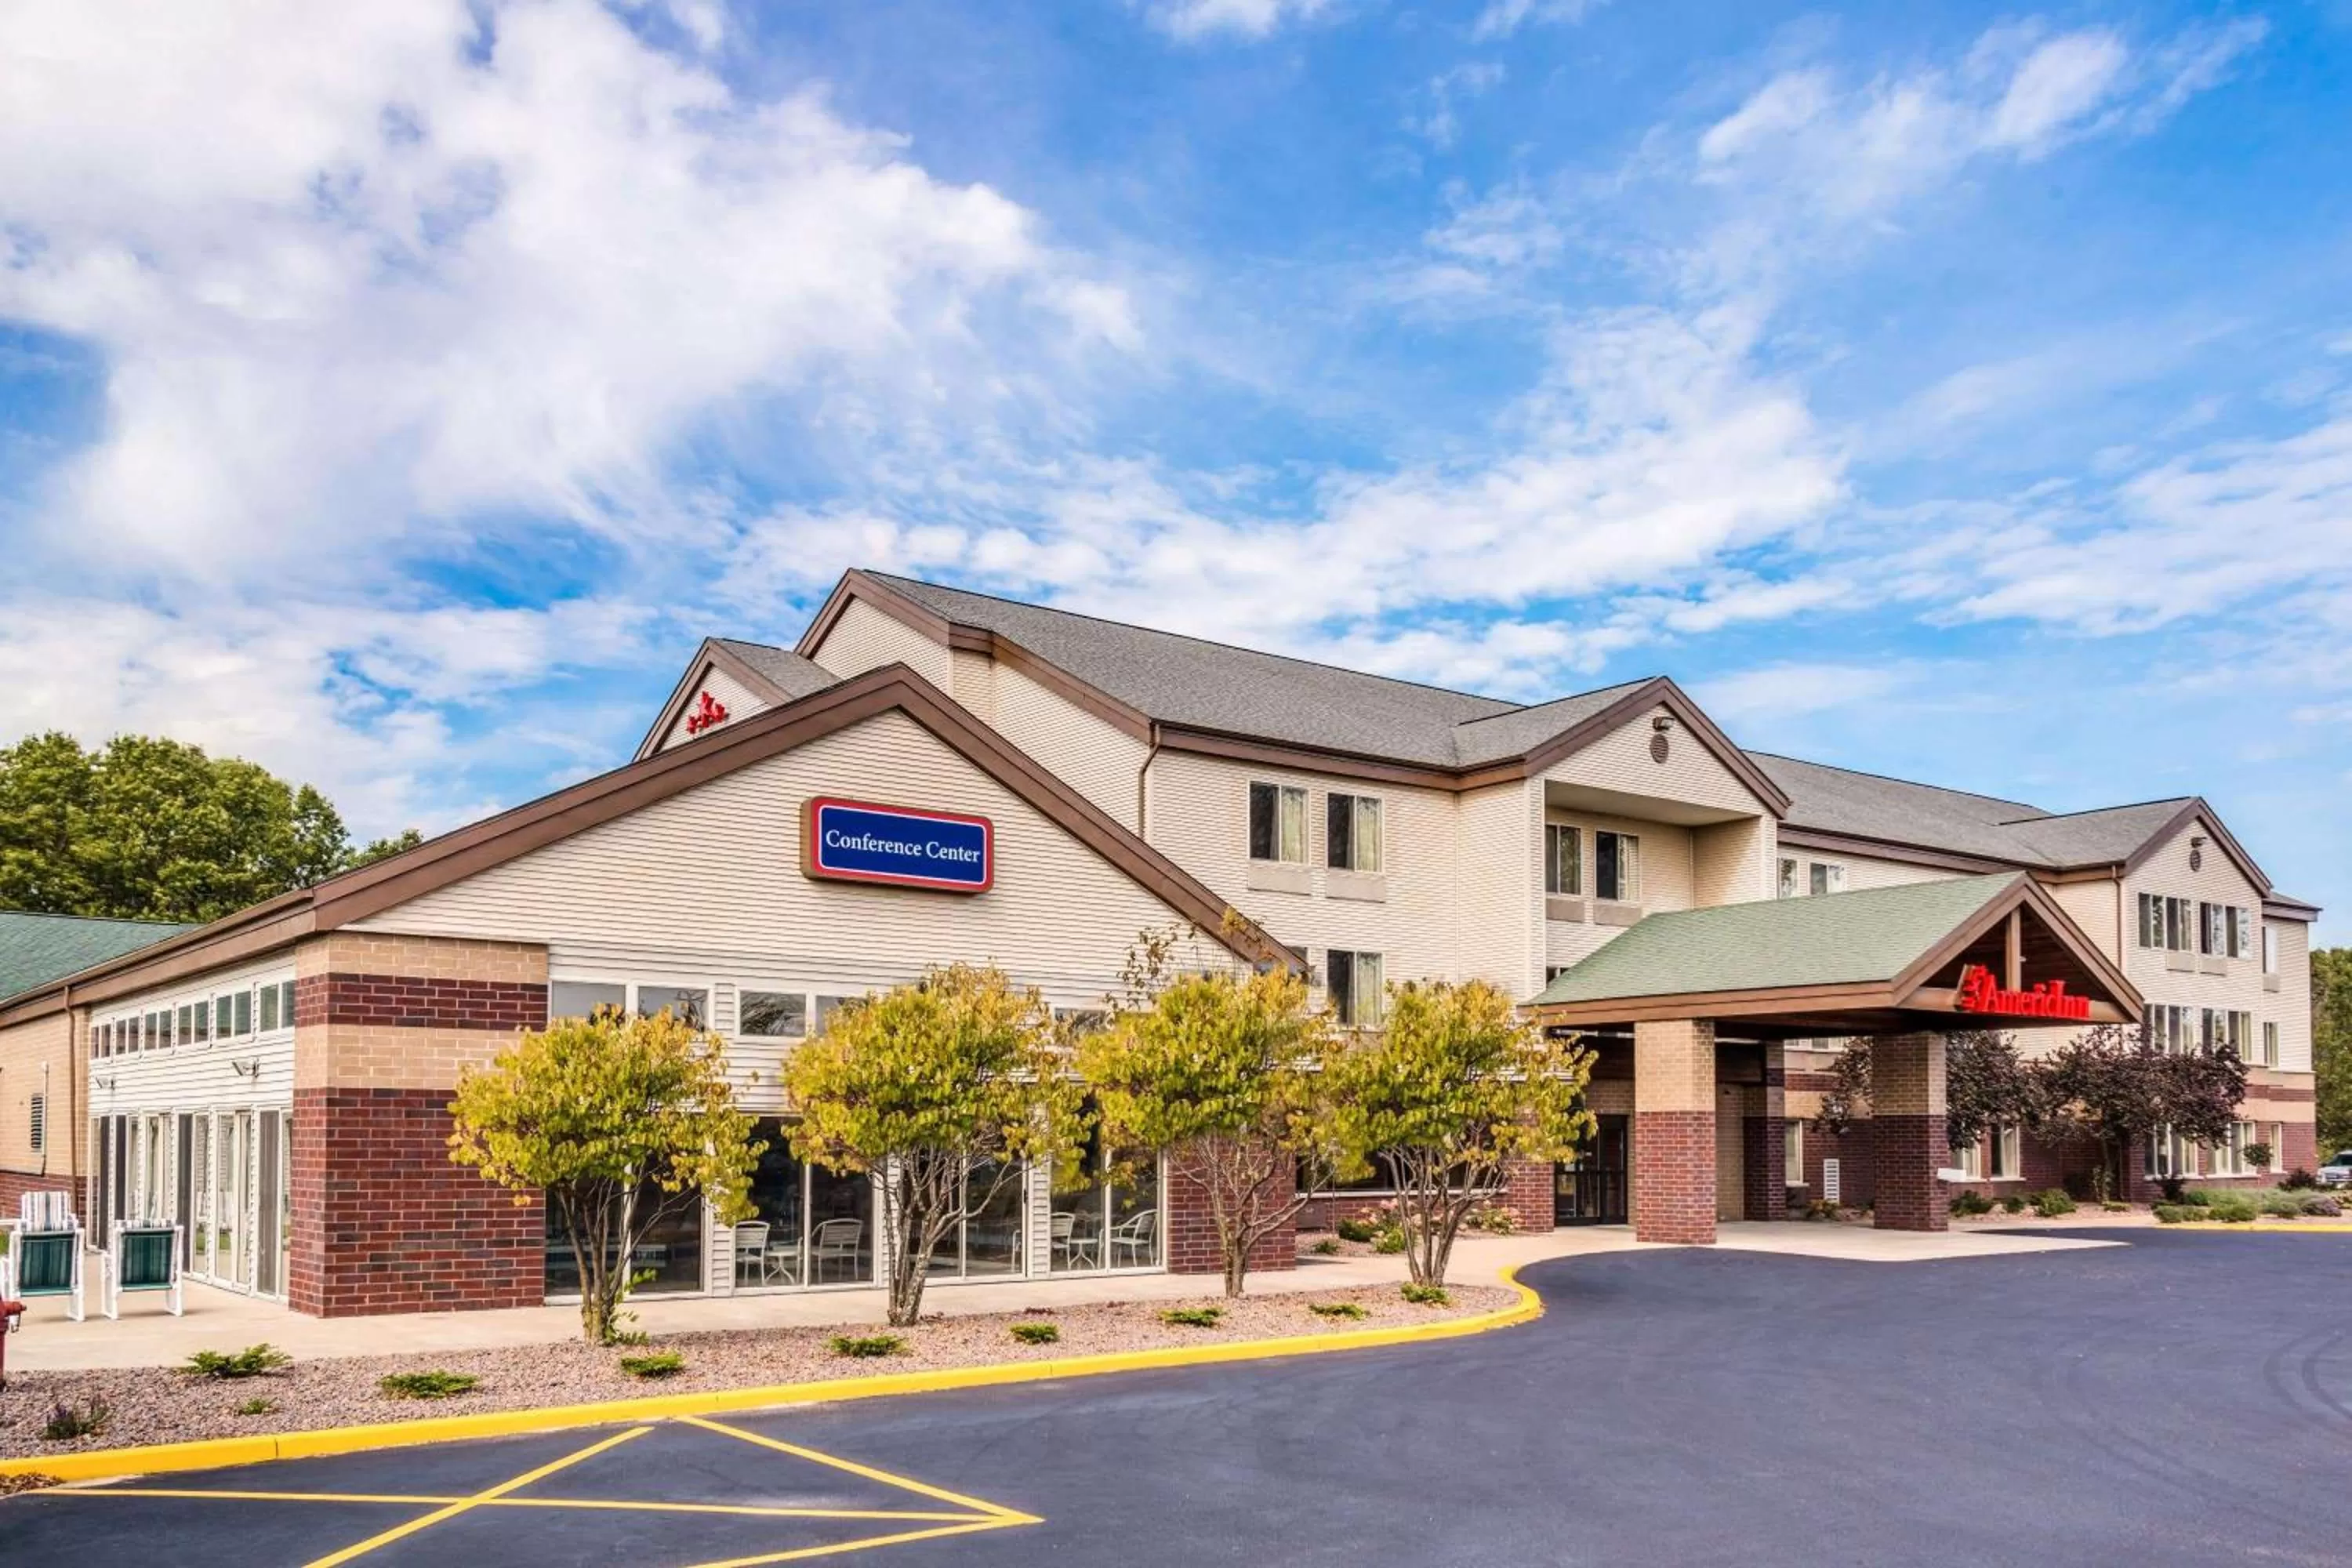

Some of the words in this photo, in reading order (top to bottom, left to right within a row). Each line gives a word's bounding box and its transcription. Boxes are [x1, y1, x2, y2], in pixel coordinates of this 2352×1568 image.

[826, 829, 922, 856] Conference
[926, 841, 980, 862] Center
[1983, 975, 2091, 1019] AmericInn
